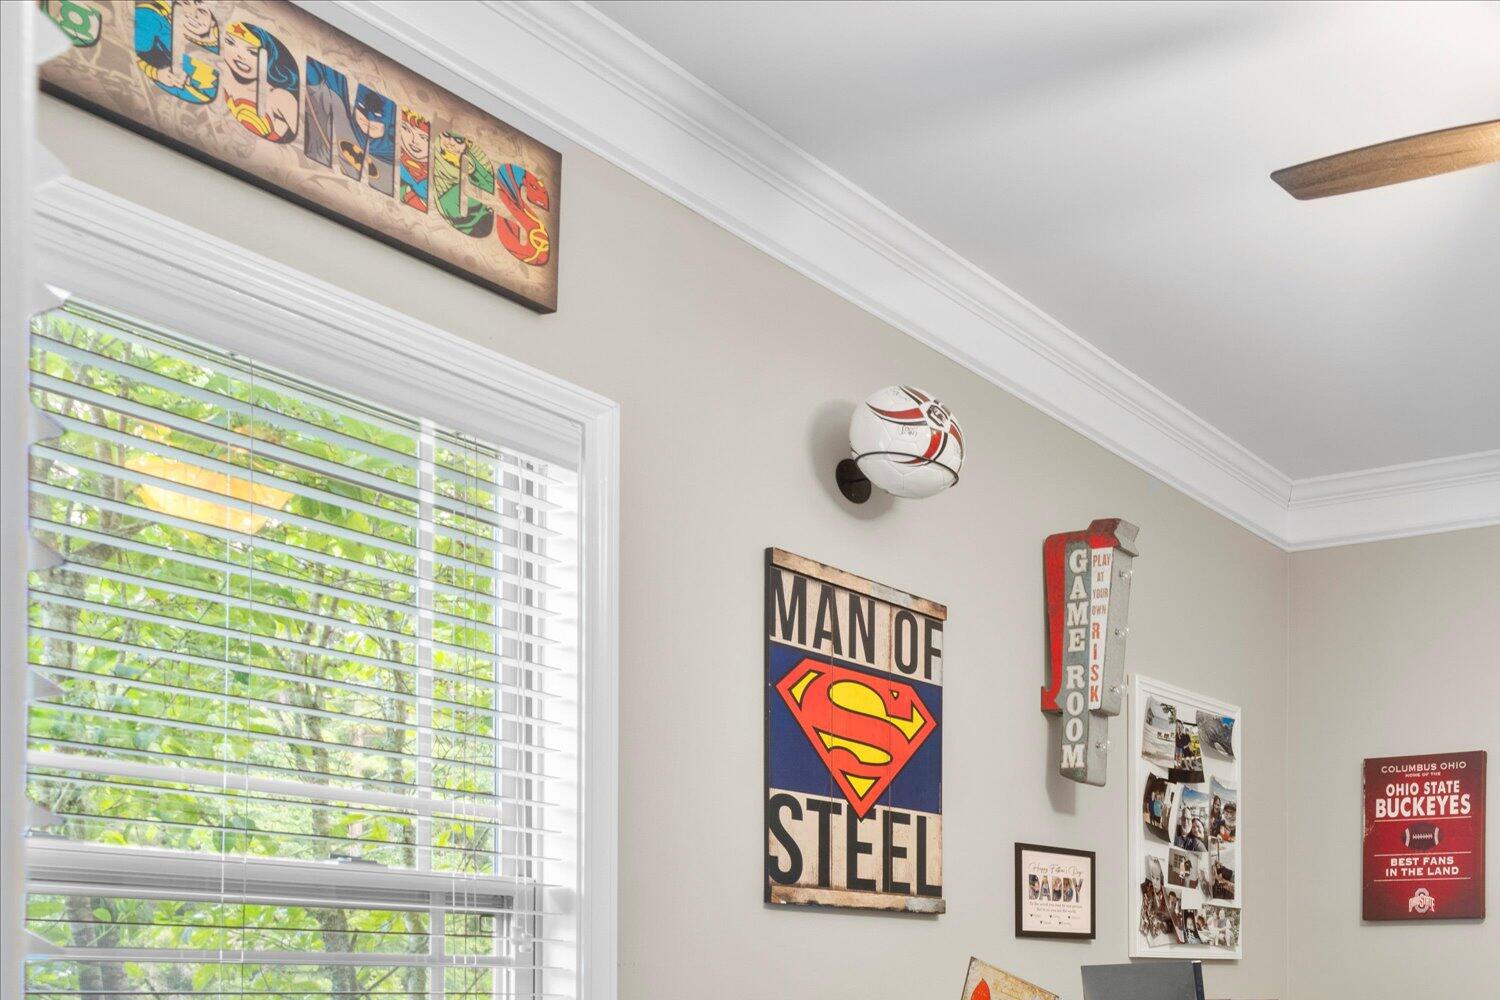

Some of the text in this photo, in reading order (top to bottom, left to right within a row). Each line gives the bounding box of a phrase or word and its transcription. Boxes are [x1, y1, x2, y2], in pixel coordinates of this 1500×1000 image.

[135, 0, 550, 266] COMICS
[1092, 553, 1111, 567] PLAY
[1096, 571, 1105, 582] AT
[1093, 587, 1109, 599] YOUR
[1091, 605, 1107, 616] OWN
[769, 567, 943, 680] MAN OF
[1061, 548, 1089, 768] GAME ROOM
[1090, 621, 1101, 703] RISK
[1381, 761, 1467, 774] COLUMBUS OHIO
[1385, 780, 1460, 797] OHIO STATE
[1375, 793, 1471, 818] BUCKEYES
[769, 793, 943, 897] STEEL
[1390, 856, 1454, 867] BEST FANS
[1385, 866, 1460, 877] IN THE LAND
[1028, 874, 1083, 903] DADDY
